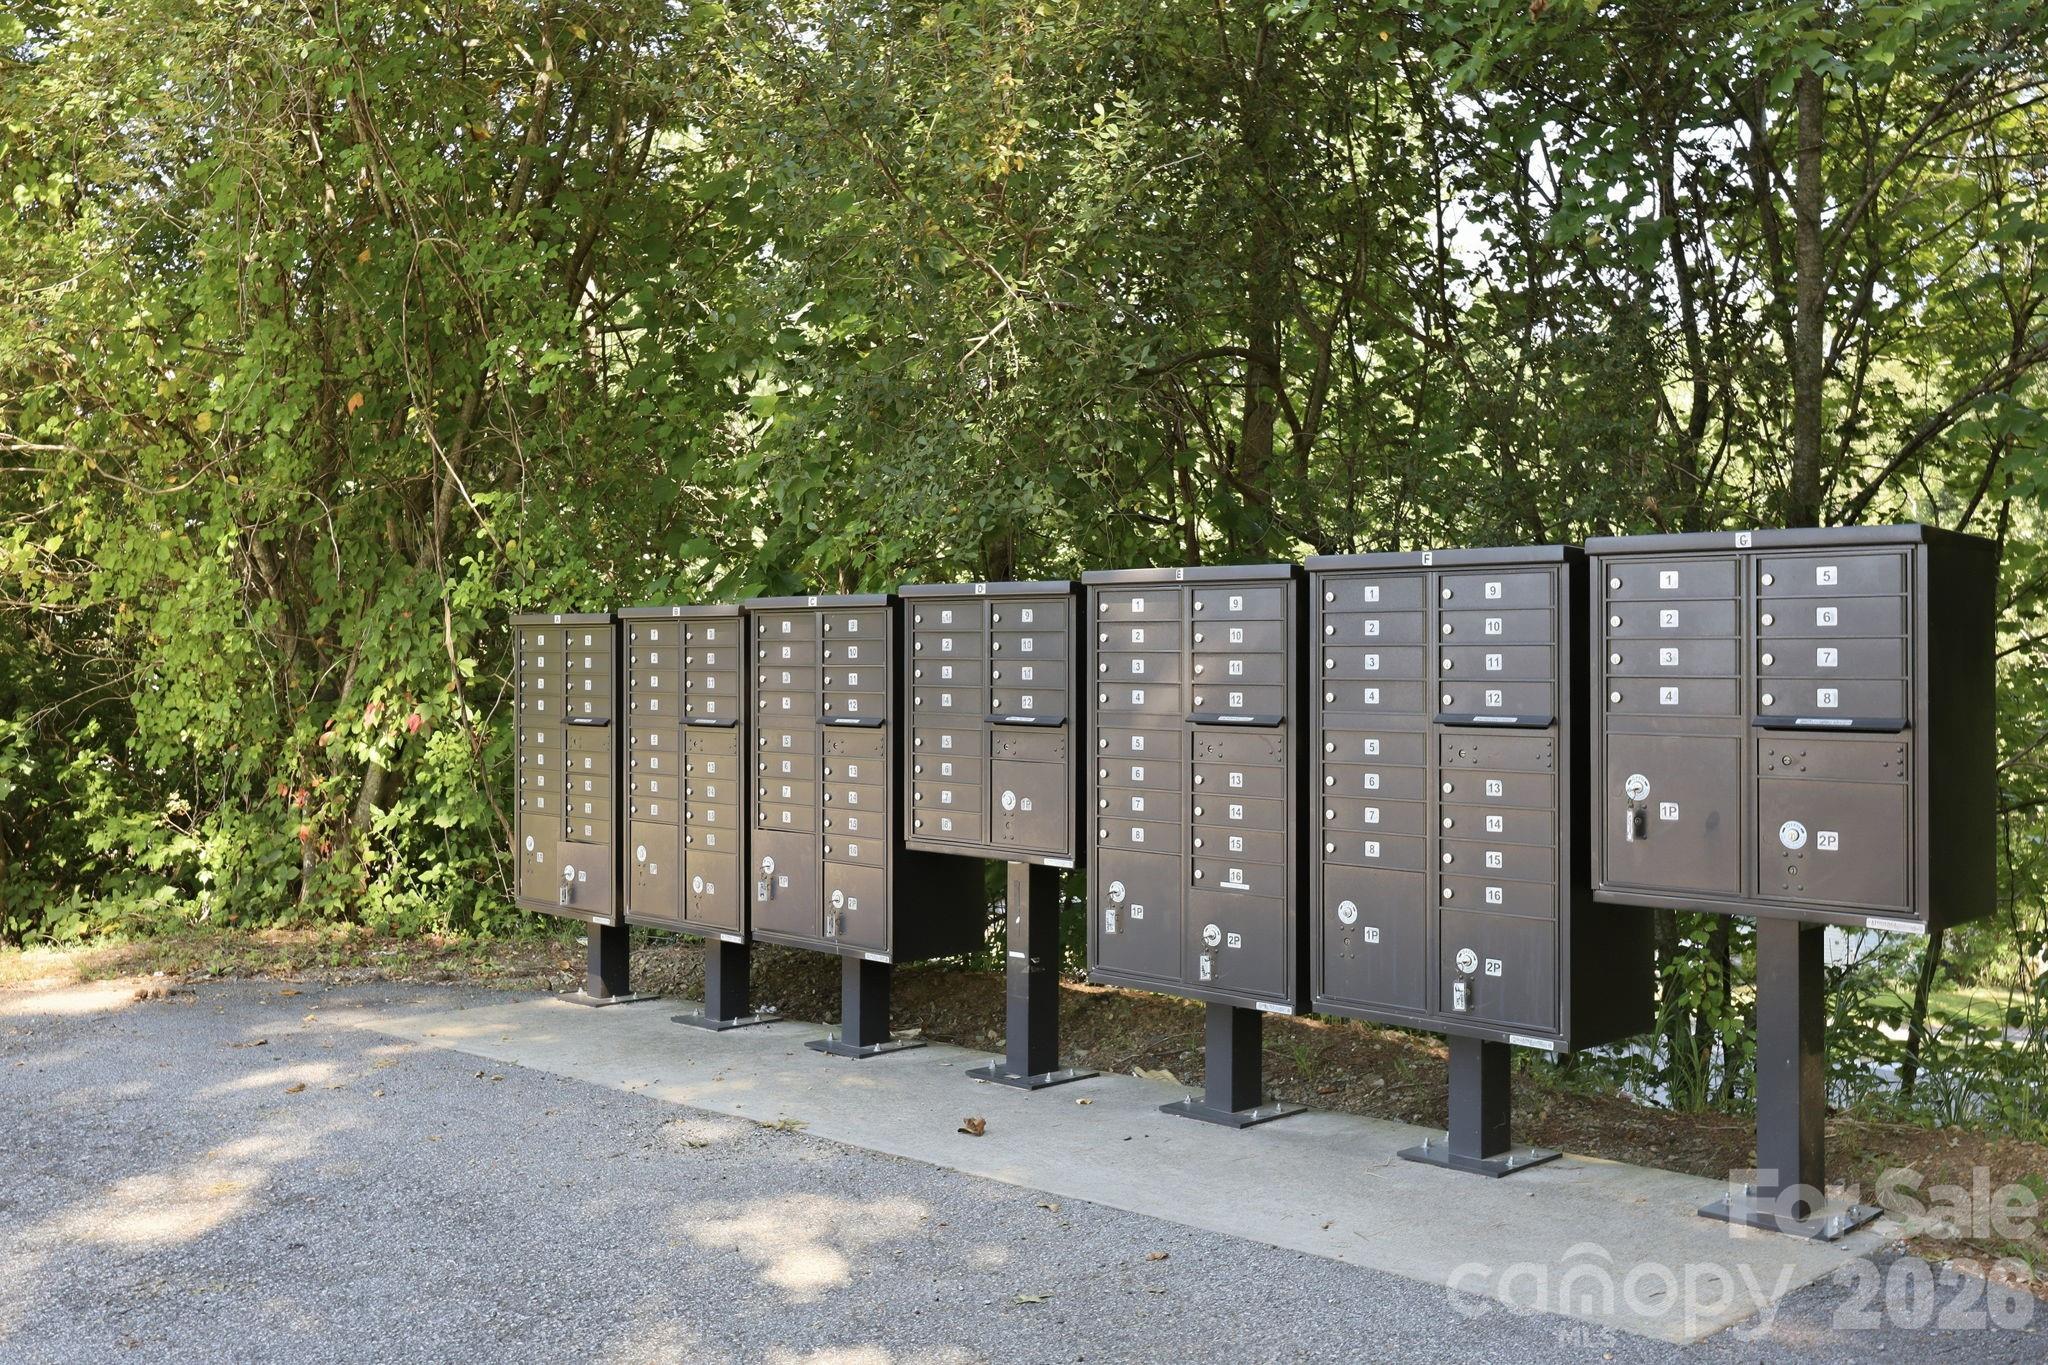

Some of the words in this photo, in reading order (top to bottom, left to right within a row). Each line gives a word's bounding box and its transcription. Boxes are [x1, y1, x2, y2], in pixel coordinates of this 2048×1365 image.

[1740, 534, 1748, 546] G
[1424, 554, 1430, 564] F
[1667, 575, 1671, 585] 1
[1823, 570, 1831, 582] 5
[1490, 586, 1496, 596] 9
[1233, 599, 1238, 608] 9
[1666, 614, 1673, 624] 2
[1823, 612, 1831, 622] 6
[1369, 623, 1375, 633] 2
[1488, 621, 1500, 632] 10
[1135, 631, 1140, 640] 2
[1231, 631, 1242, 640] 10
[1370, 657, 1375, 667] 3
[1488, 657, 1499, 667] 11
[1666, 652, 1672, 662] 3
[1824, 652, 1831, 663] 7
[1136, 662, 1141, 671] 3
[1230, 663, 1241, 672] 11
[1135, 693, 1140, 701] 4
[1230, 695, 1242, 704] 12
[1369, 692, 1374, 701] 4
[1488, 693, 1500, 703] 12
[1665, 691, 1672, 702] 4
[1824, 693, 1831, 704] 8
[1136, 738, 1140, 748] 5
[1370, 742, 1375, 752] 5
[1135, 769, 1140, 778] 6
[1230, 775, 1242, 785] 13
[1369, 776, 1375, 786] 6
[1488, 783, 1500, 793] 13
[1135, 800, 1140, 808] 7
[1230, 808, 1242, 816] 14
[1369, 810, 1374, 820] 7
[1662, 806, 1676, 817] 1P
[1489, 819, 1500, 829] 14
[1135, 830, 1140, 840] 8
[1230, 840, 1241, 849] 15
[1820, 835, 1836, 846] 2P
[1369, 844, 1375, 854] 8
[1488, 854, 1500, 866] 15
[1231, 871, 1241, 881] 16
[1488, 890, 1500, 901] 16
[1132, 907, 1143, 916] 1P
[1366, 930, 1377, 940] 1P
[1229, 936, 1240, 945] 2P
[1488, 962, 1500, 972] 2P
